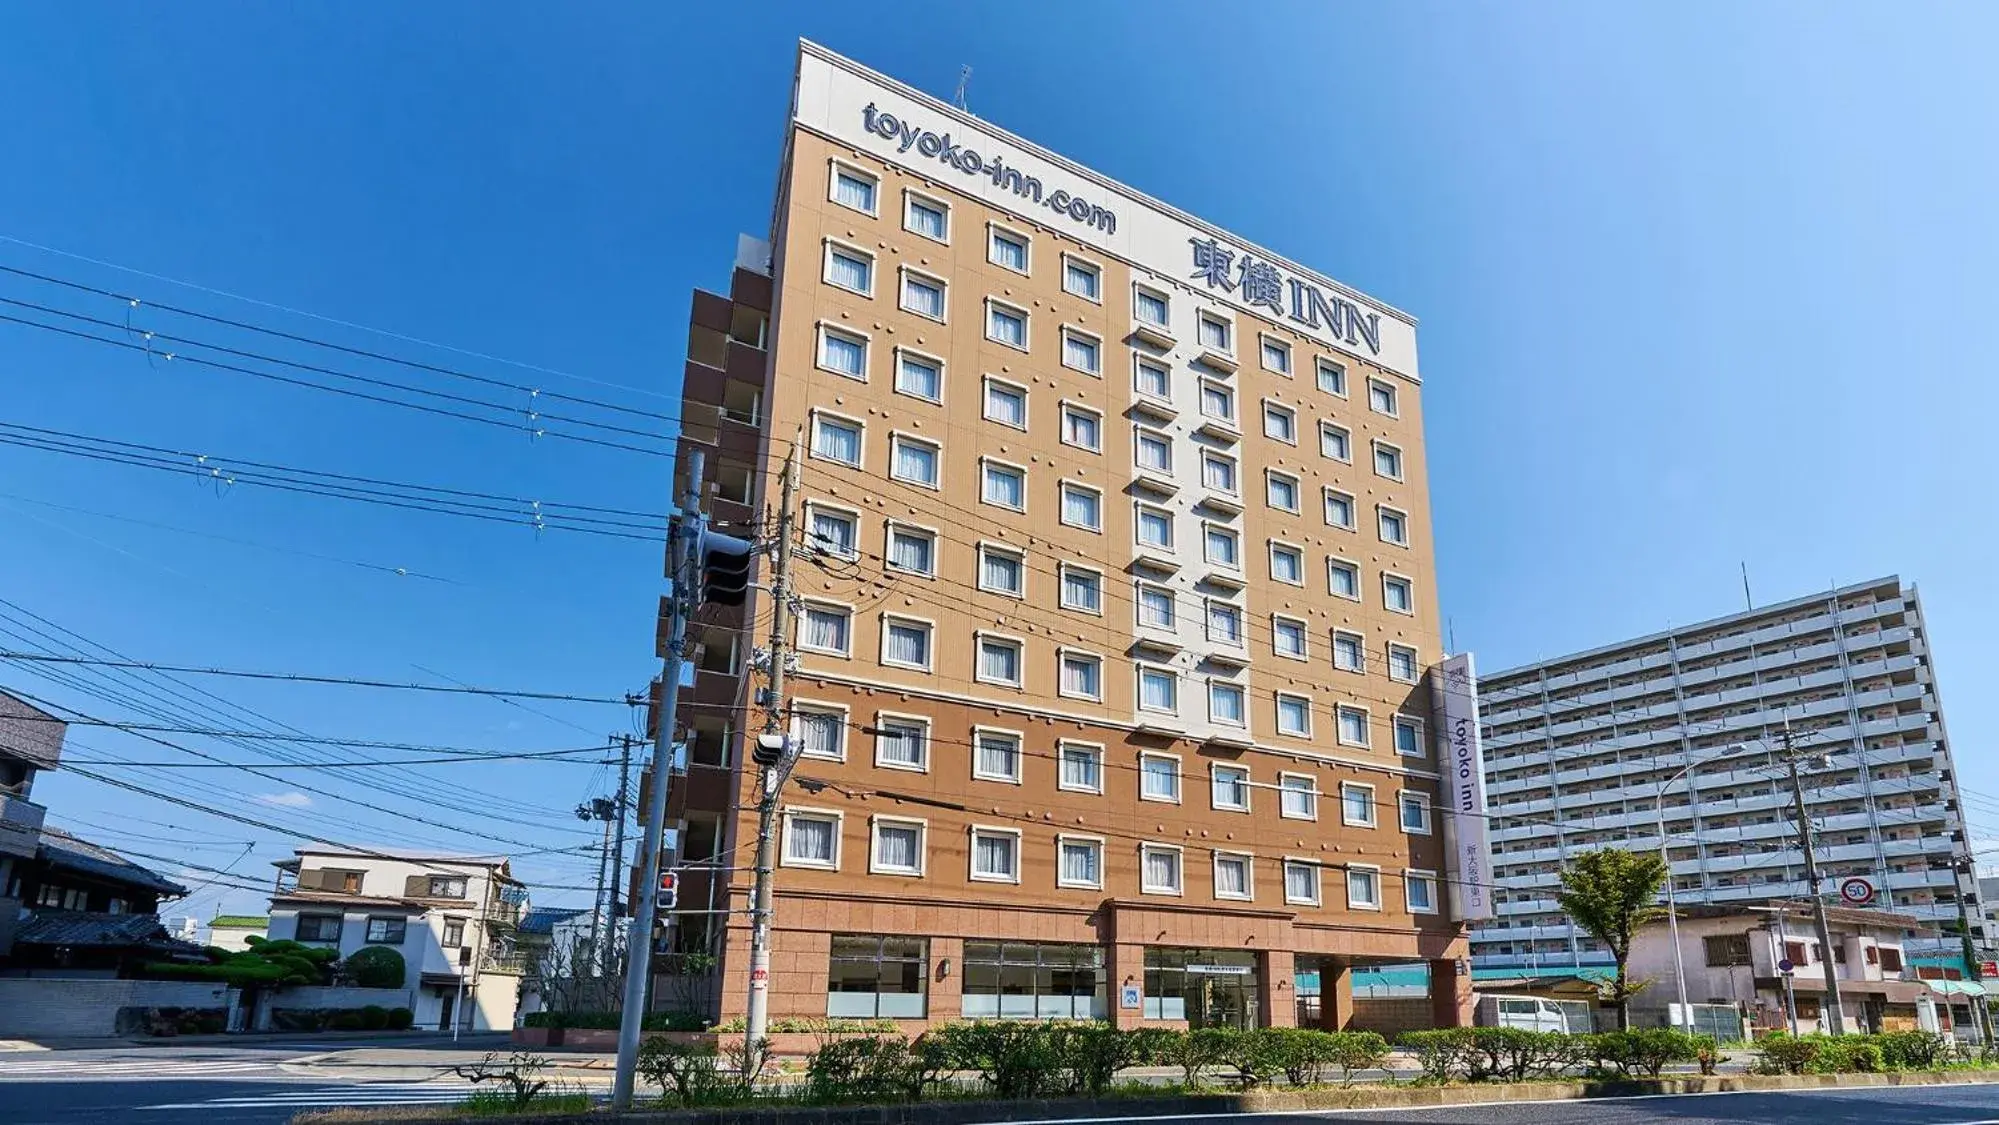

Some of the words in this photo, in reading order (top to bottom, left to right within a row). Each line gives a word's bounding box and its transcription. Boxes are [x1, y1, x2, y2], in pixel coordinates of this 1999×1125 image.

[862, 102, 1116, 235] toyoko-inn.com
[1454, 718, 1472, 778] toyoko
[1461, 782, 1475, 811] inn
[1847, 884, 1866, 897] 50
